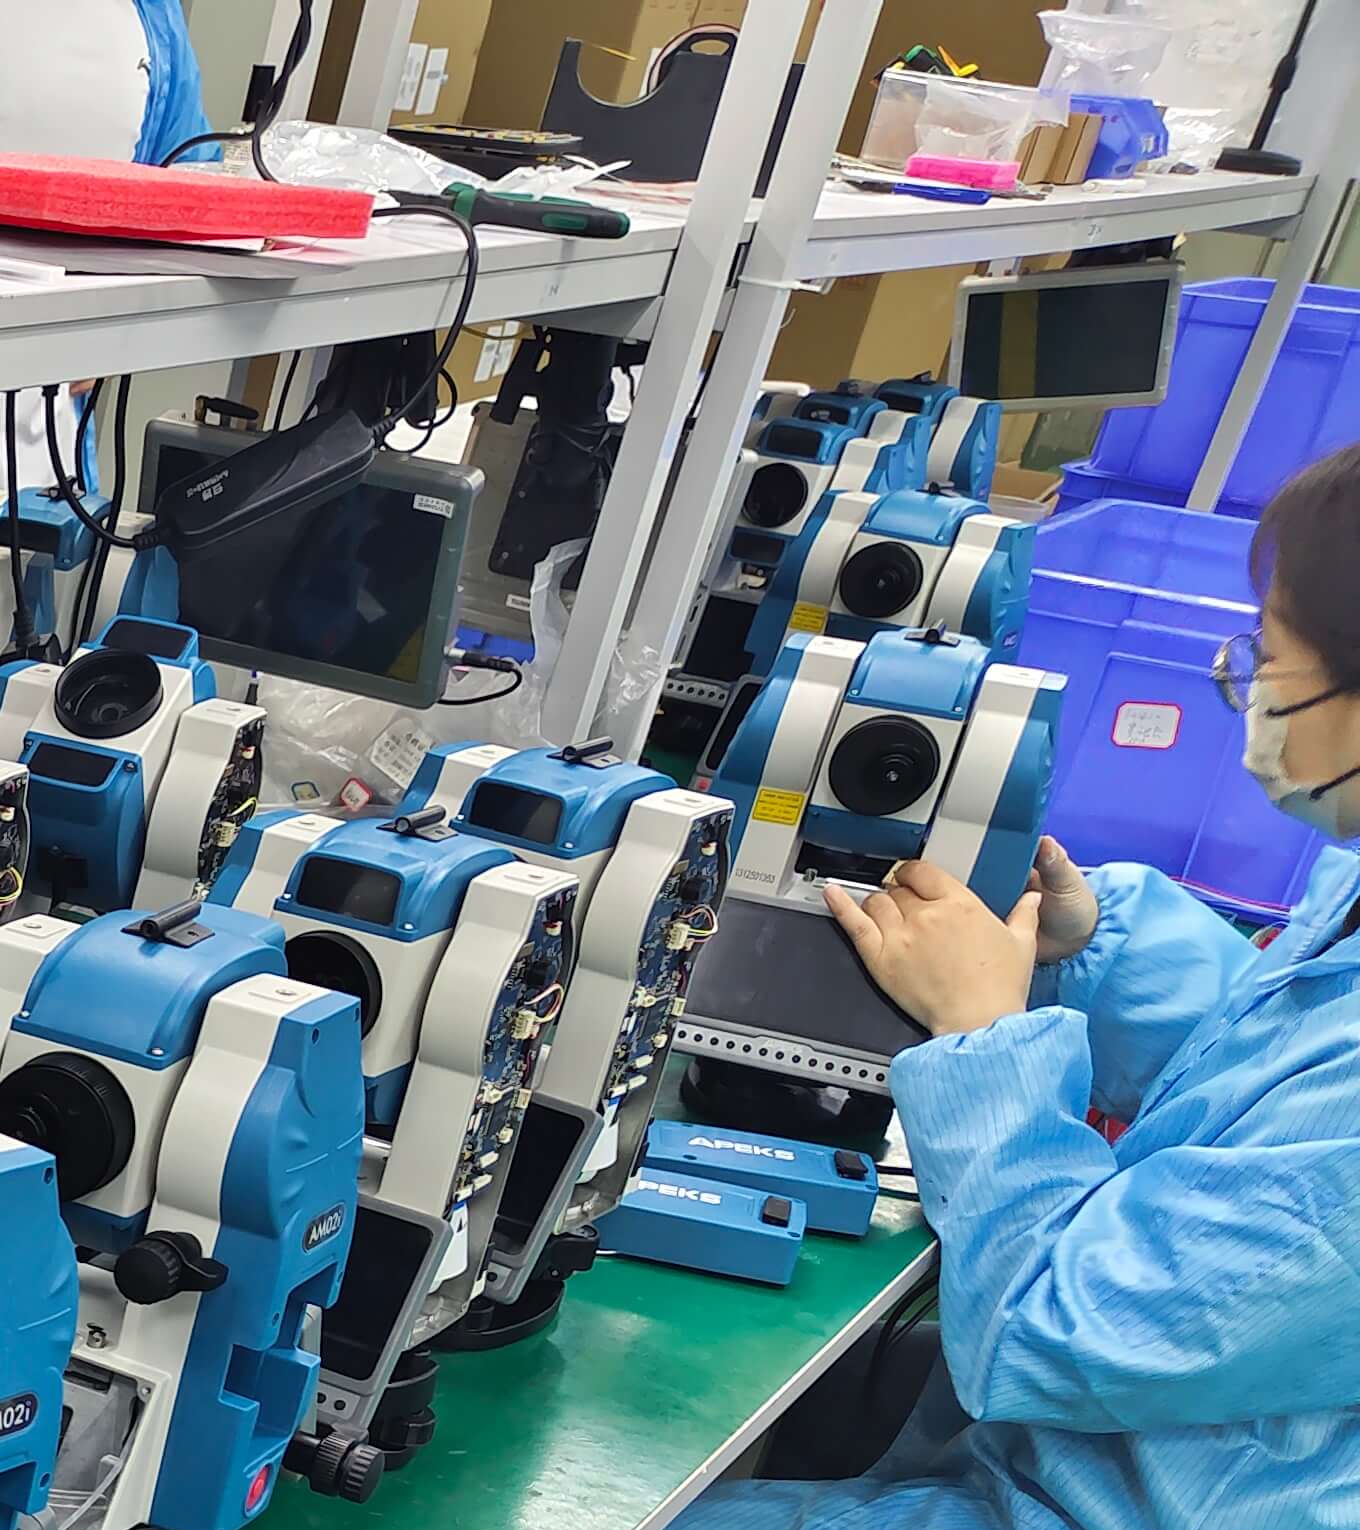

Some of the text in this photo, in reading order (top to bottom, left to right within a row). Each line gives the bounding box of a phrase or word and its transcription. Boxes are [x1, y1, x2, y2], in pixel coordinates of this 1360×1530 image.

[687, 1136, 796, 1162] APEKS
[637, 1179, 722, 1206] PEKS
[308, 1208, 343, 1245] AM02i
